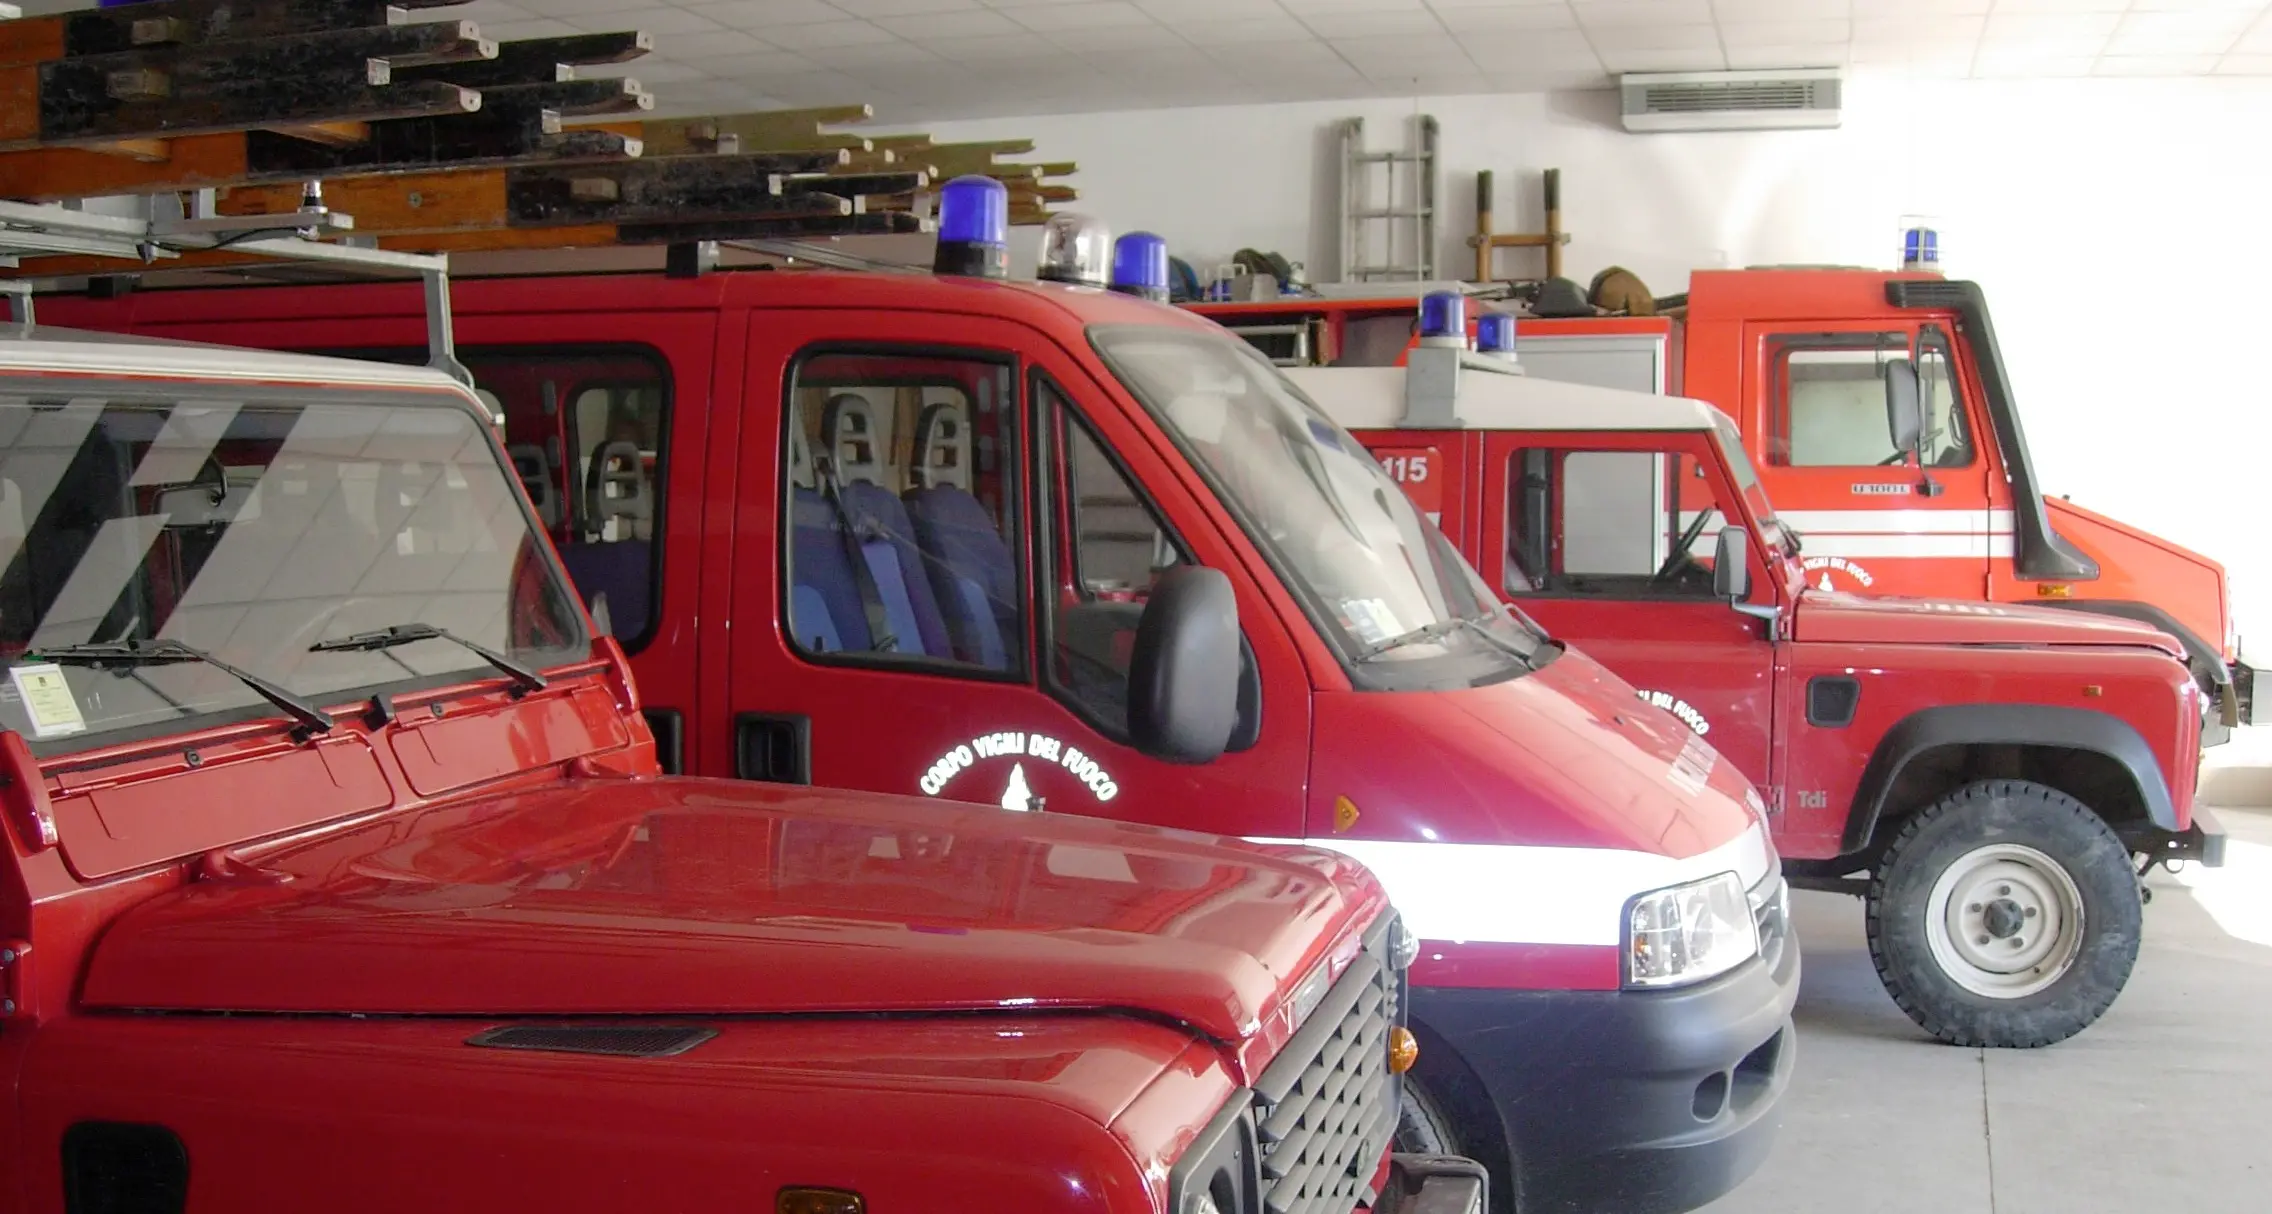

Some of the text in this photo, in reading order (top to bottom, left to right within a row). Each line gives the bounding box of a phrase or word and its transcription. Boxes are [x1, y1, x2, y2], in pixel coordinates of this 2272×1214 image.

[1381, 456, 1428, 482] 115
[1673, 700, 1710, 736] FUOCO
[920, 732, 1118, 802] CORPO VIGILI DEL FUOCO
[1798, 790, 1828, 809] Tdi
